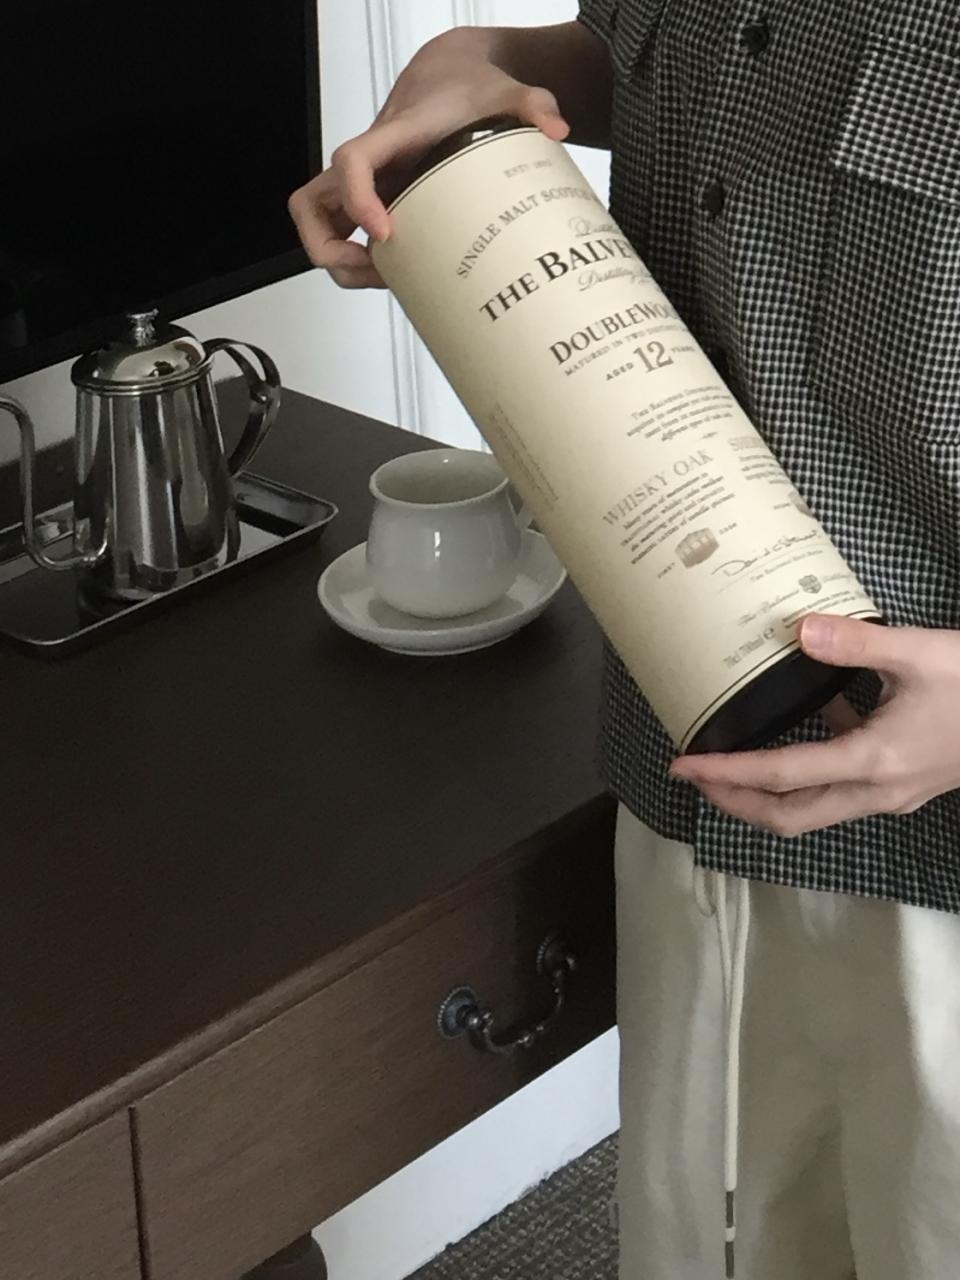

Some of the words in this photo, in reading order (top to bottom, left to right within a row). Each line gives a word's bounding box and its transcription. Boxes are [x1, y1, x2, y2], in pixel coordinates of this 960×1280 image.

[457, 223, 501, 279] SINGLE
[498, 195, 540, 227] MALT
[479, 272, 540, 323] THE
[534, 238, 635, 282] BALVE
[606, 362, 634, 381] AGED
[633, 340, 675, 373] 12
[602, 471, 668, 526] WHISKY
[673, 449, 714, 477] OAK
